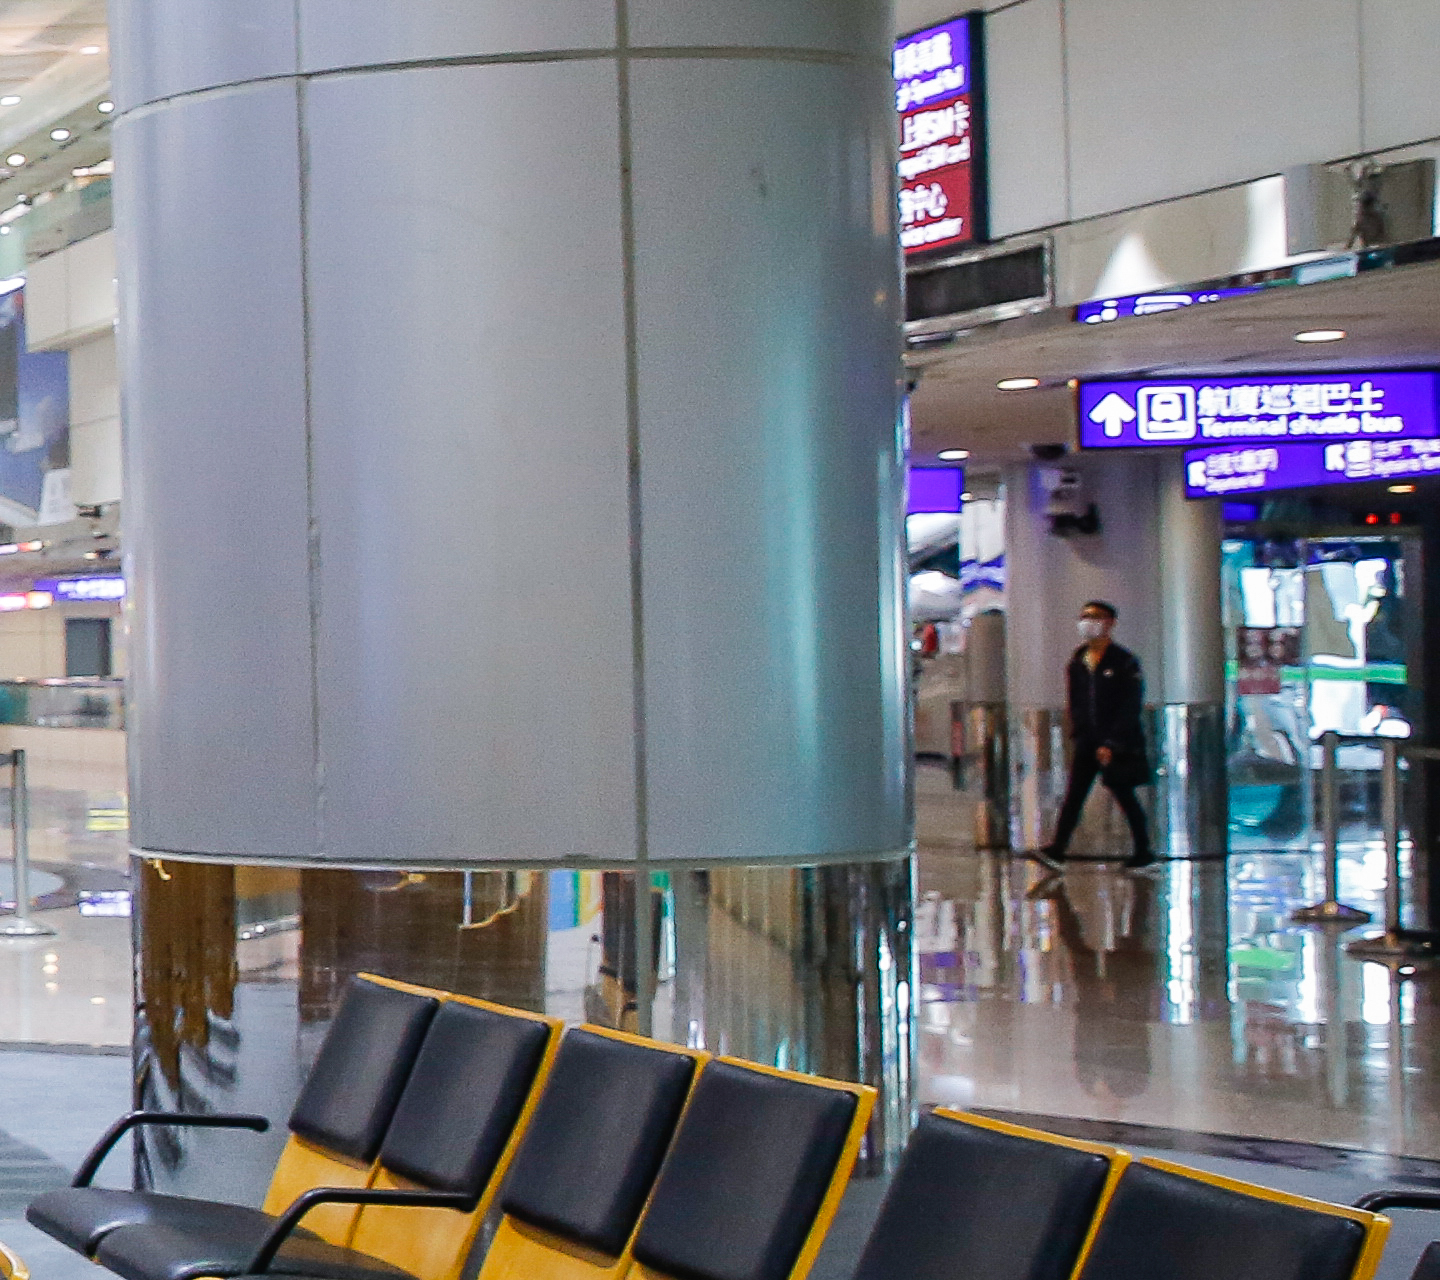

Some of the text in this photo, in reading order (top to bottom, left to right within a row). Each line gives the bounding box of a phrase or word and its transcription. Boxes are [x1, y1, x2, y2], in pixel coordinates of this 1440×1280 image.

[1198, 412, 1404, 438] Terminal shuttle bus
